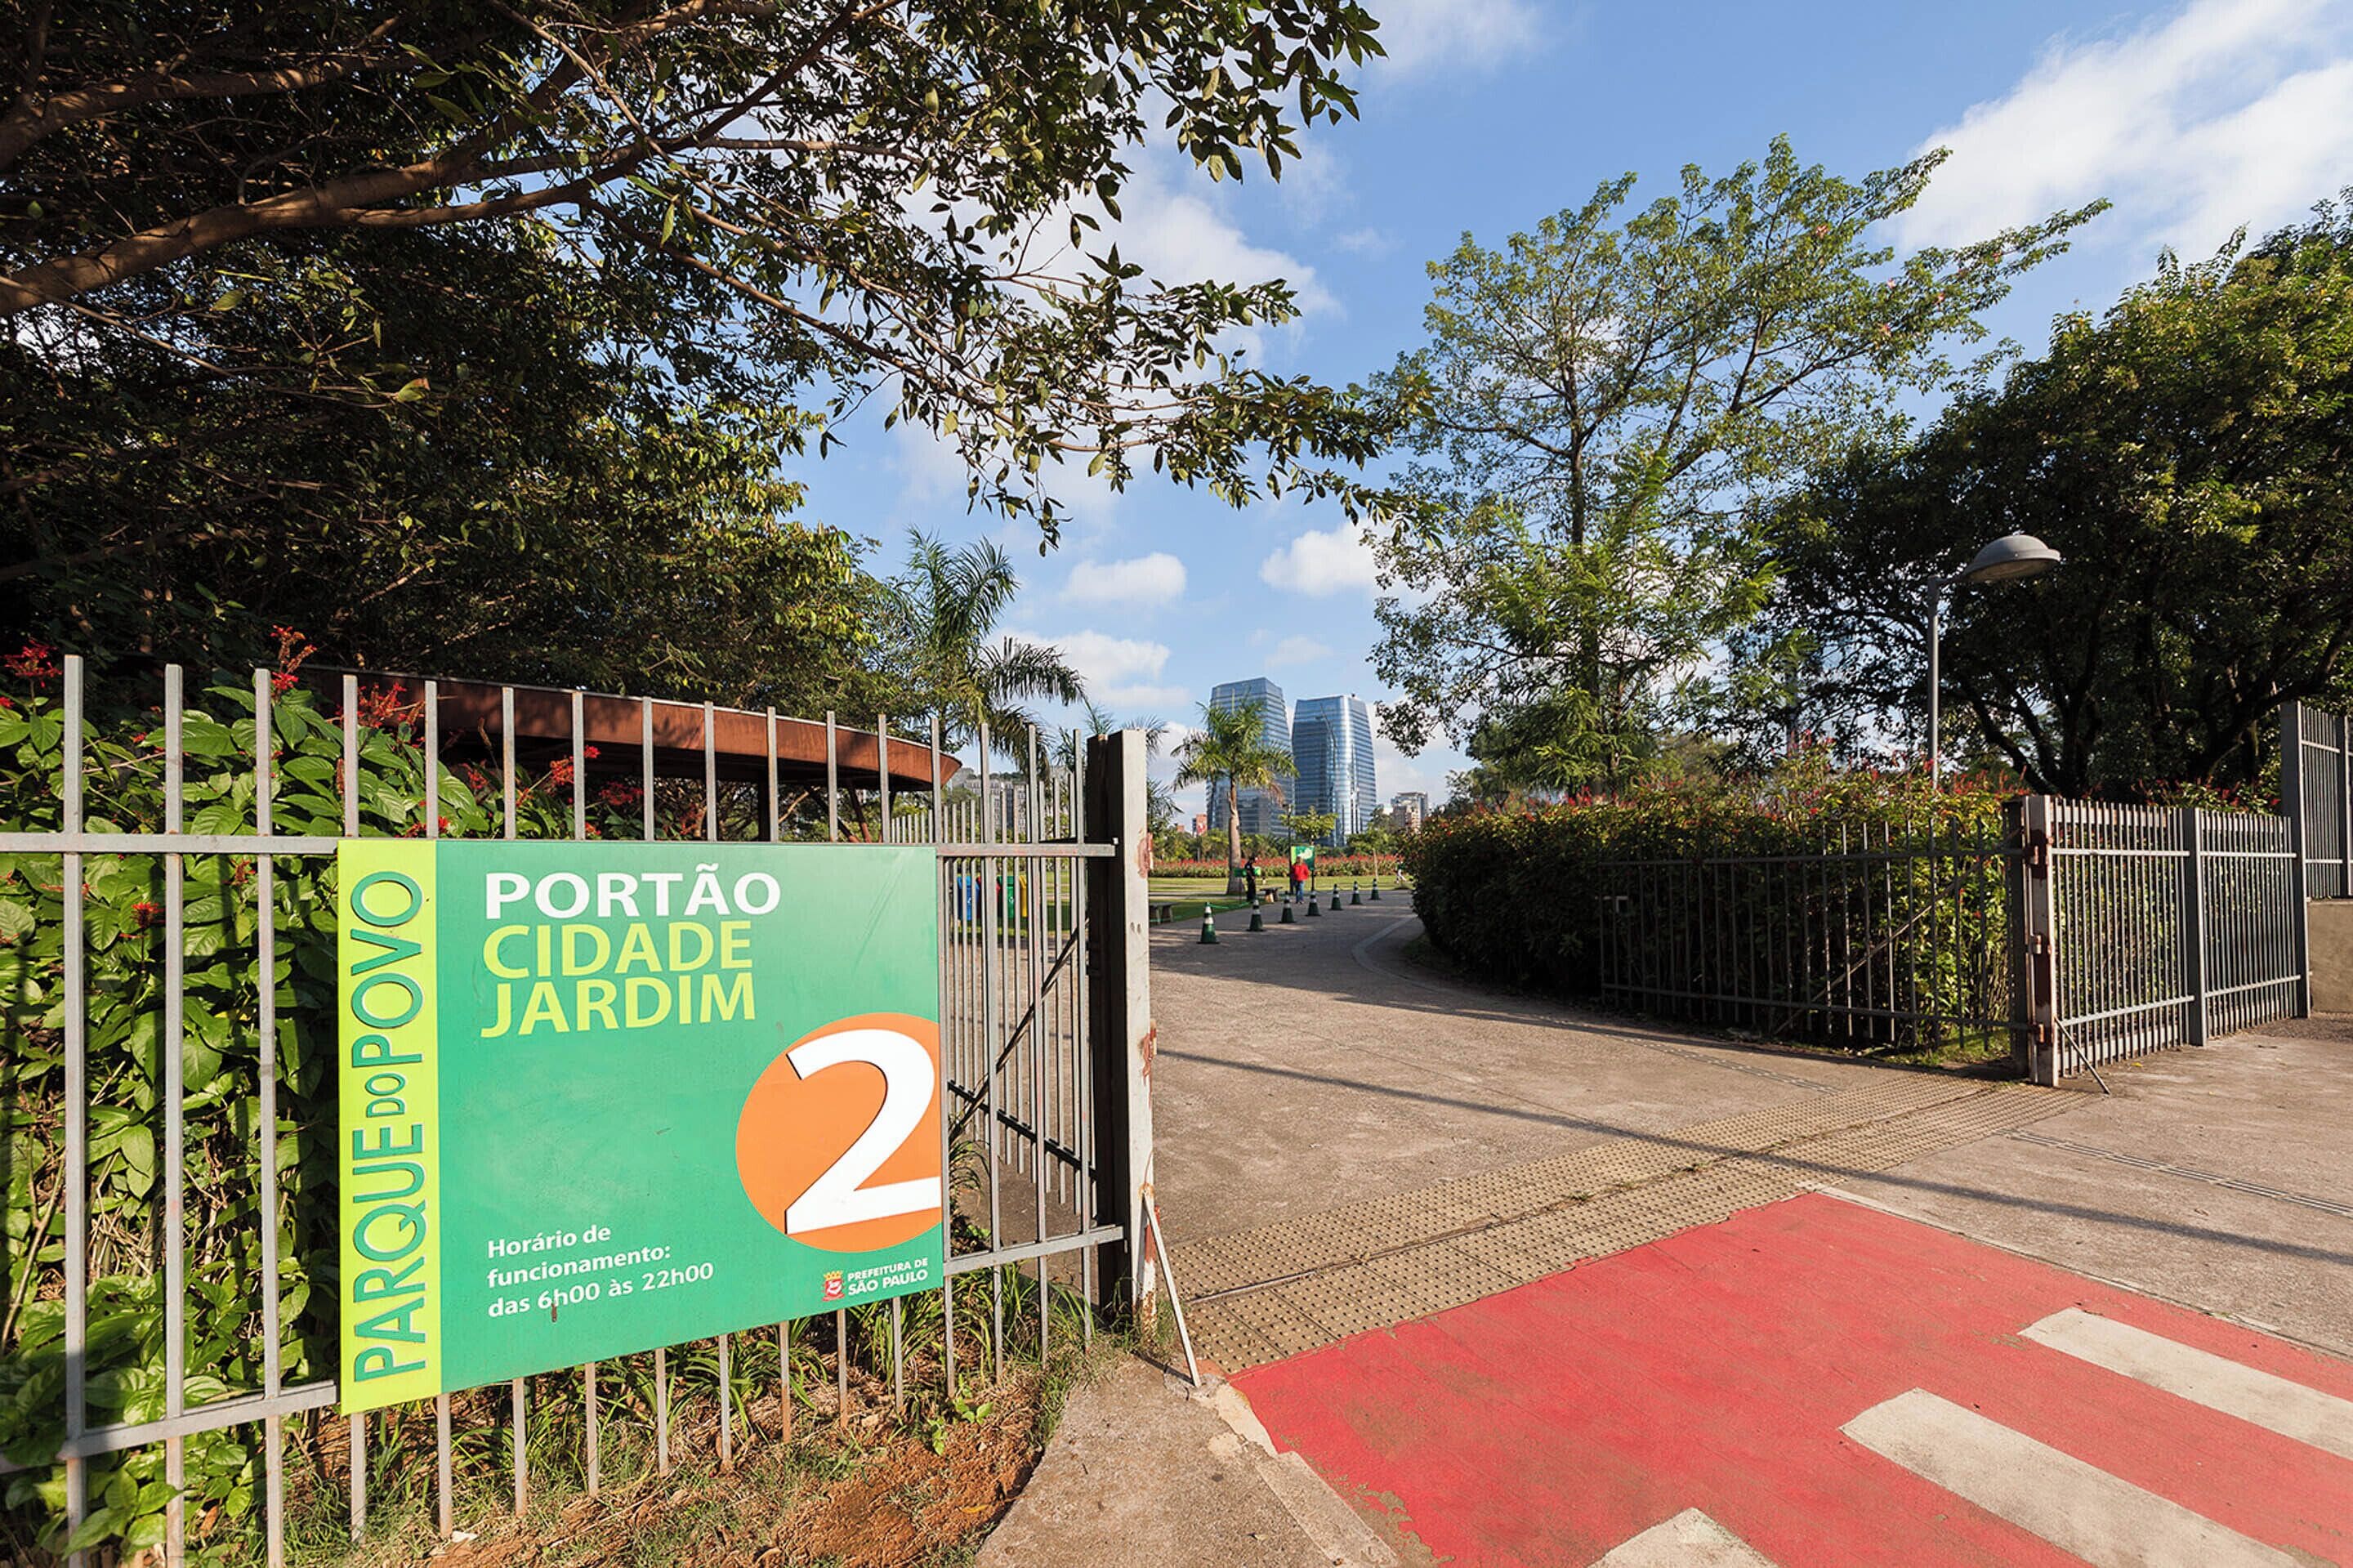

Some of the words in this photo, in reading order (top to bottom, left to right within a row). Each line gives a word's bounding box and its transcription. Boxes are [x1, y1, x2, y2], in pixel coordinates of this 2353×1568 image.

[485, 863, 781, 919] PORTÃO
[350, 871, 423, 1067] POVO
[483, 921, 753, 979] CIDADE
[481, 972, 756, 1038] JARDIM
[366, 1073, 407, 1118] DO
[785, 1029, 941, 1235] 2
[352, 1124, 426, 1383] PARQUE
[487, 1245, 671, 1288] funcionamento:
[488, 1230, 577, 1258] Horário
[583, 1225, 611, 1244] de
[848, 1262, 911, 1280] PREFEITURA
[915, 1258, 928, 1268] DE
[488, 1297, 530, 1317] das
[538, 1282, 601, 1309] 6h00
[608, 1279, 633, 1297] às
[641, 1262, 714, 1291] 22h00
[848, 1280, 878, 1296] SÃO
[883, 1270, 928, 1288] PAULO
